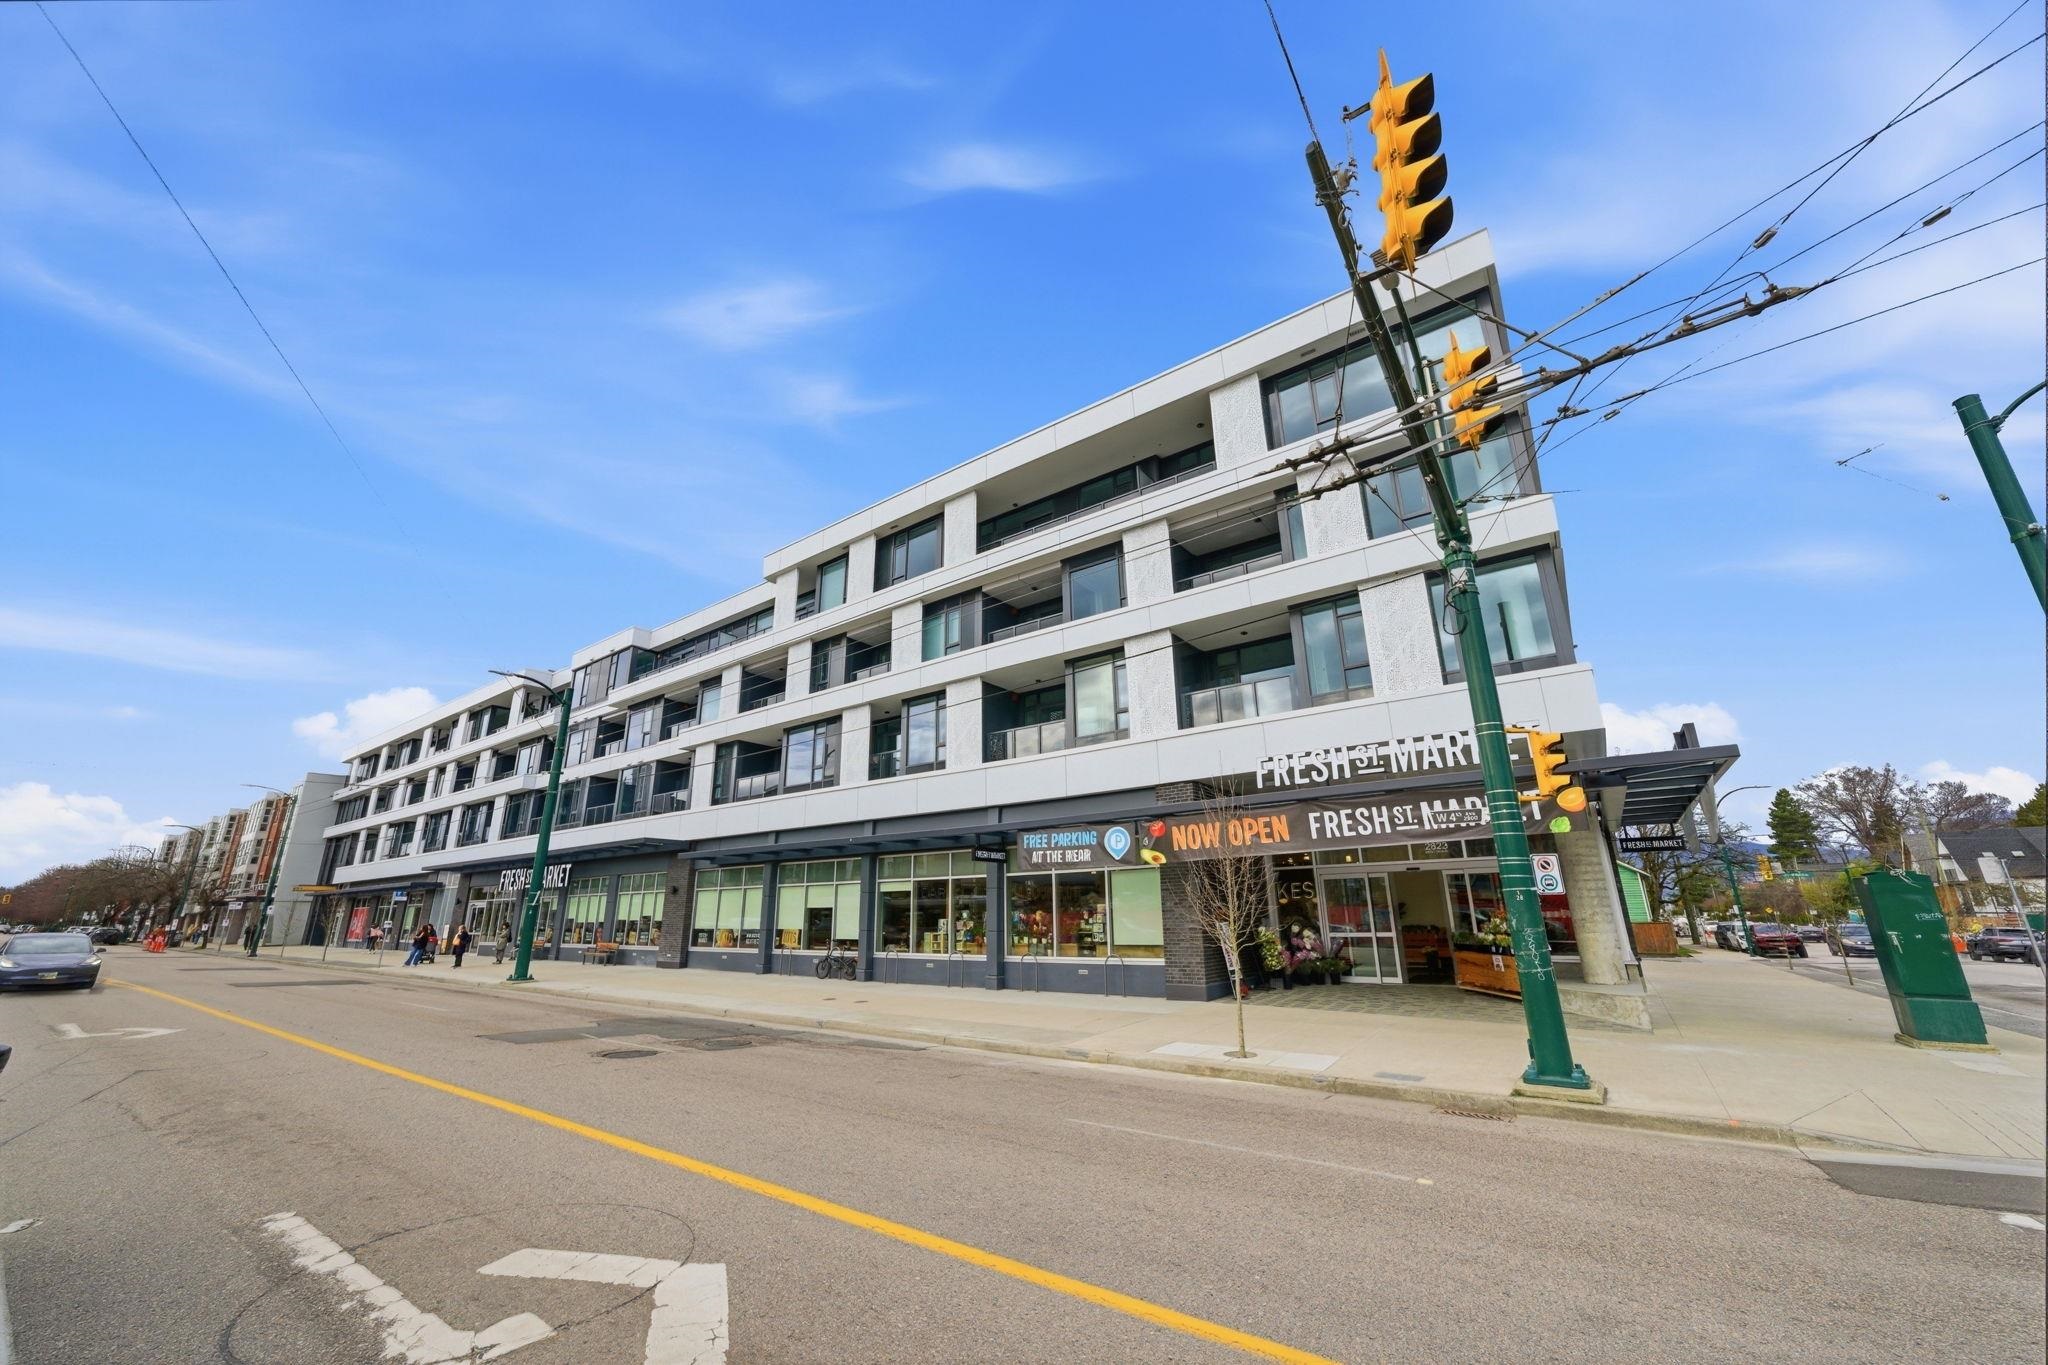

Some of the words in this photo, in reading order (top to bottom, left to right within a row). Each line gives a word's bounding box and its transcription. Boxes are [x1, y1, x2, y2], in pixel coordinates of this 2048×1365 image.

[1256, 746, 1352, 789] FRESH
[1308, 805, 1392, 840] FRESH
[1436, 813, 1447, 823] W
[1023, 833, 1049, 849] FREE
[1051, 830, 1097, 848] PARKING
[1171, 822, 1220, 851] NOW
[1228, 814, 1290, 846] OPEN
[1622, 840, 1646, 849] FRESH
[1653, 839, 1683, 848] MARKET
[1045, 850, 1063, 863] THE
[1065, 848, 1092, 862] REAR
[499, 868, 527, 891] FRESH
[543, 863, 572, 889] ARKET
